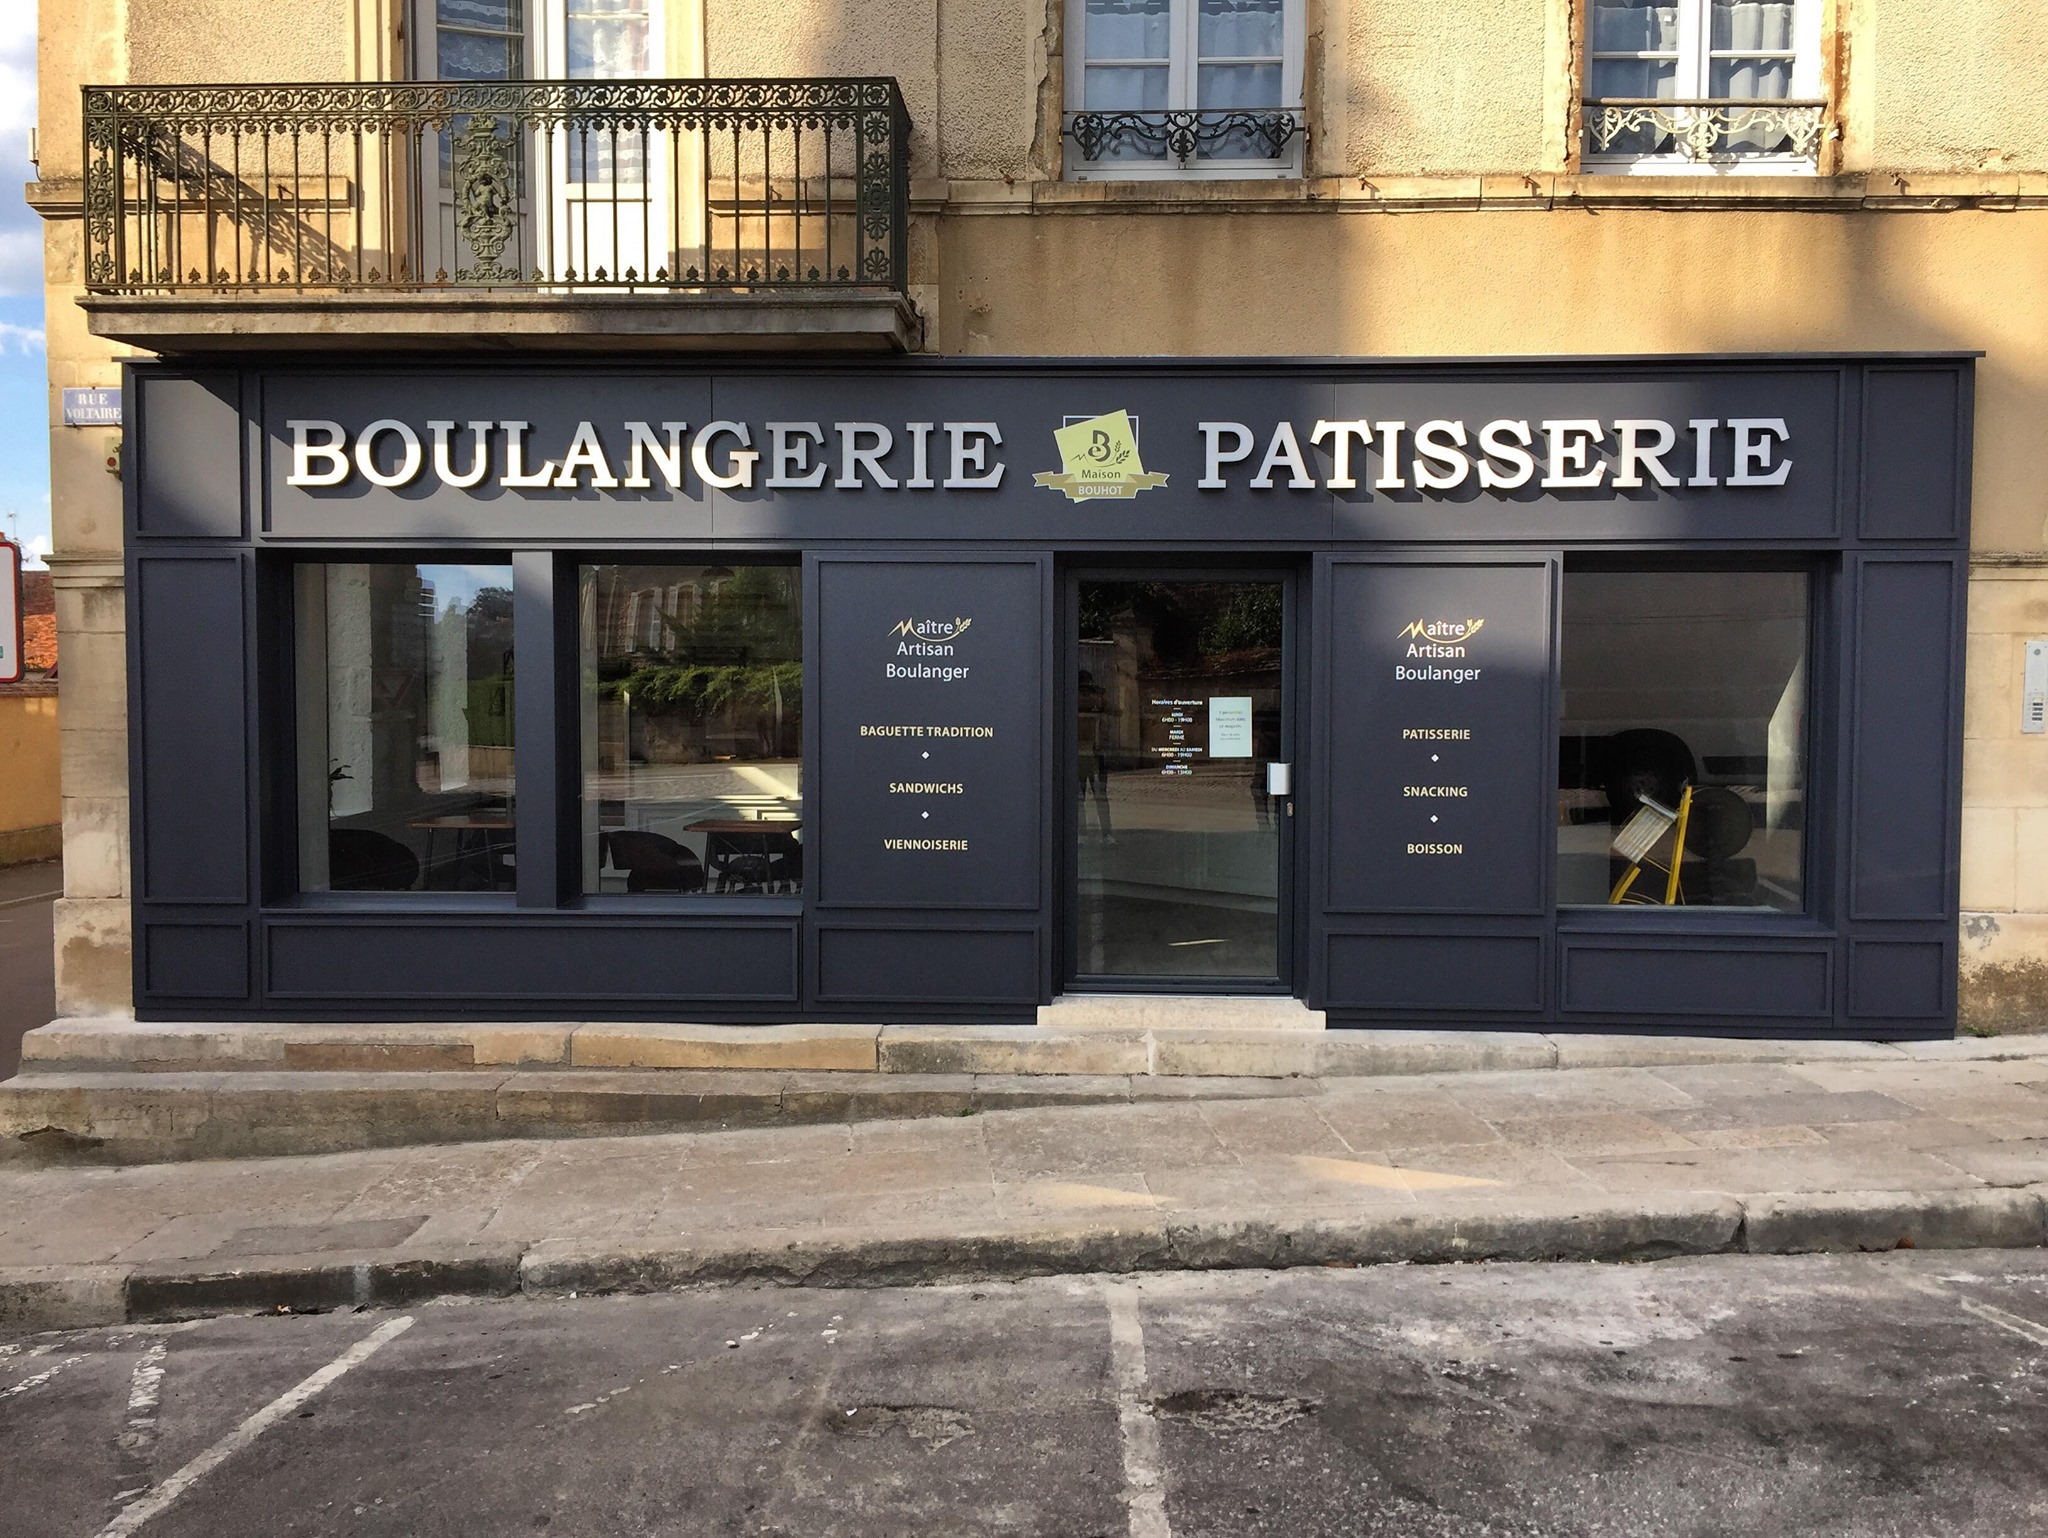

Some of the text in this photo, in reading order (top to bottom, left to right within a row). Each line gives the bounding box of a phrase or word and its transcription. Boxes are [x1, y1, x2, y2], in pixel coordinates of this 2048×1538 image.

[78, 393, 108, 405] RUE
[65, 407, 122, 419] VOLTAIRE
[286, 419, 1005, 490] BOULANGERIE
[1197, 418, 1793, 490] PATISSERIE
[1081, 469, 1121, 479] Maison
[1078, 485, 1124, 495] BOUHOT
[888, 617, 954, 638] Maître
[1397, 618, 1466, 640] Maître
[896, 641, 954, 656] Artisan
[1406, 643, 1466, 658] Artisan
[886, 663, 970, 682] Boulanger
[1395, 665, 1481, 684] Boulanger
[860, 726, 994, 737] BAGUETTE TRADITION
[1402, 729, 1471, 740] PATISSERIE
[889, 783, 964, 794] SANDWICHS
[1403, 786, 1468, 797] SNACKING
[884, 839, 969, 851] VIENNOISERIE
[1407, 844, 1463, 854] BOISSON
